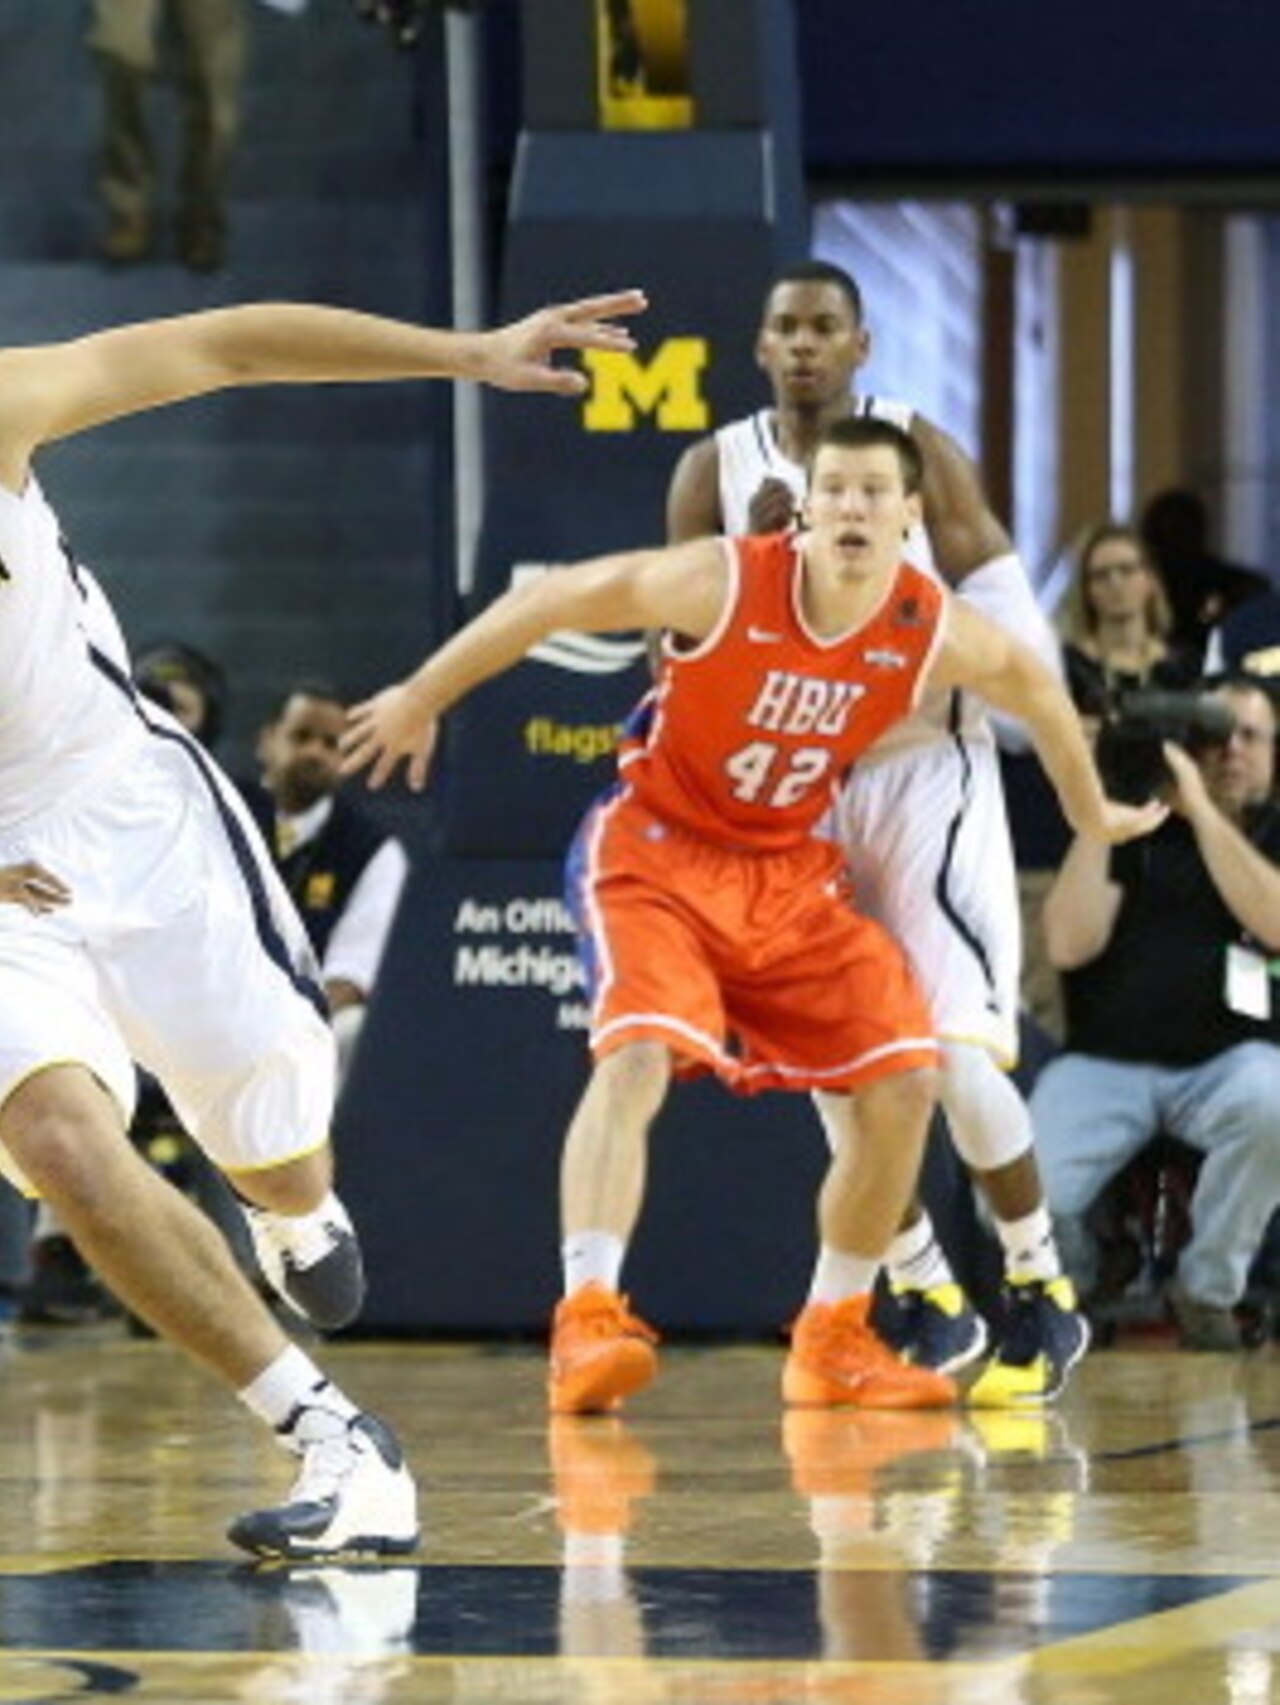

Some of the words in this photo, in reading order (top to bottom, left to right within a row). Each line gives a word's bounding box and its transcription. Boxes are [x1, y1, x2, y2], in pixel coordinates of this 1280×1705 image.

[584, 337, 706, 431] M
[748, 670, 866, 735] HBU
[526, 717, 624, 763] flags
[727, 742, 830, 807] 42
[454, 898, 498, 933] An
